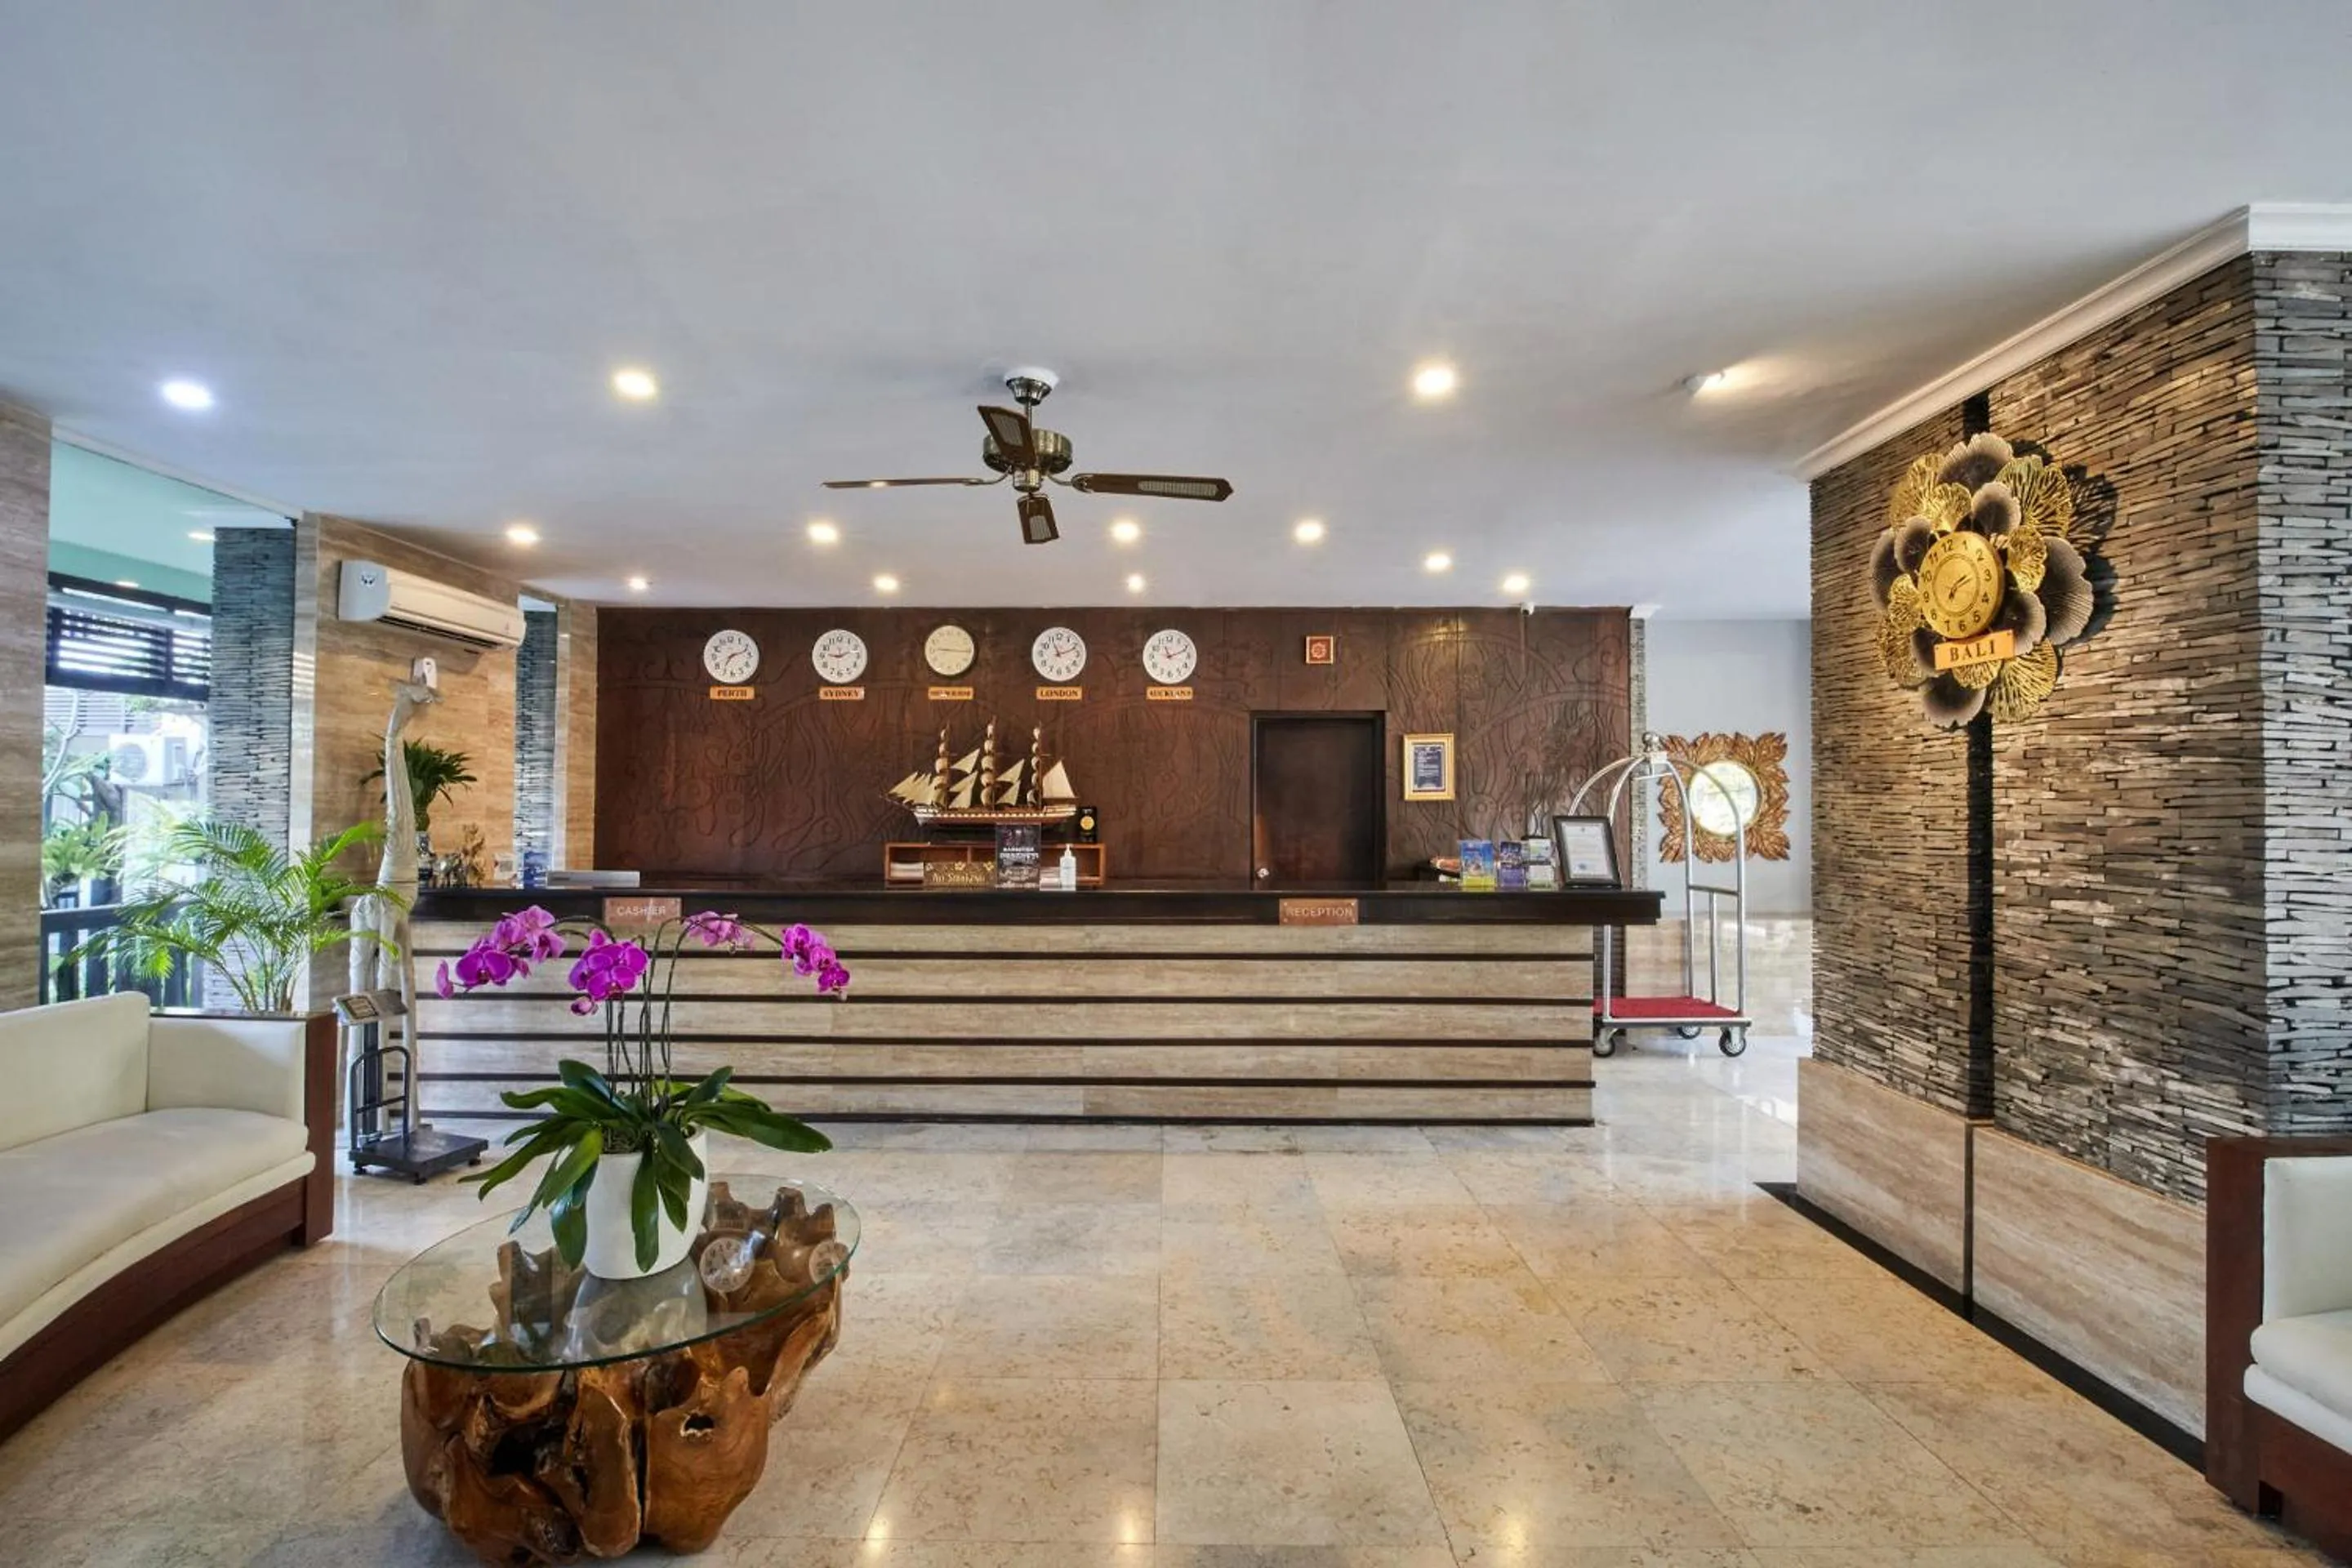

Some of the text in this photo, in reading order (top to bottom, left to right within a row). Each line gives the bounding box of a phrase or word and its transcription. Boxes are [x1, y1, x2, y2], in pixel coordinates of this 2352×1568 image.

[1942, 539, 1953, 553] 12
[1963, 540, 1968, 550] 1
[1928, 552, 1939, 565] 11
[1976, 549, 1984, 561] 2
[1922, 570, 1932, 582] 10
[1984, 568, 1991, 581] 3
[1923, 591, 1929, 603] 9
[1981, 592, 1989, 604] 4
[1973, 611, 1980, 623] 5
[1944, 621, 1950, 632] 7
[1960, 620, 1966, 631] 6
[1950, 640, 1995, 662] BALI
[823, 689, 860, 697] SYDNEY
[1285, 907, 1352, 916] RECEPTION
